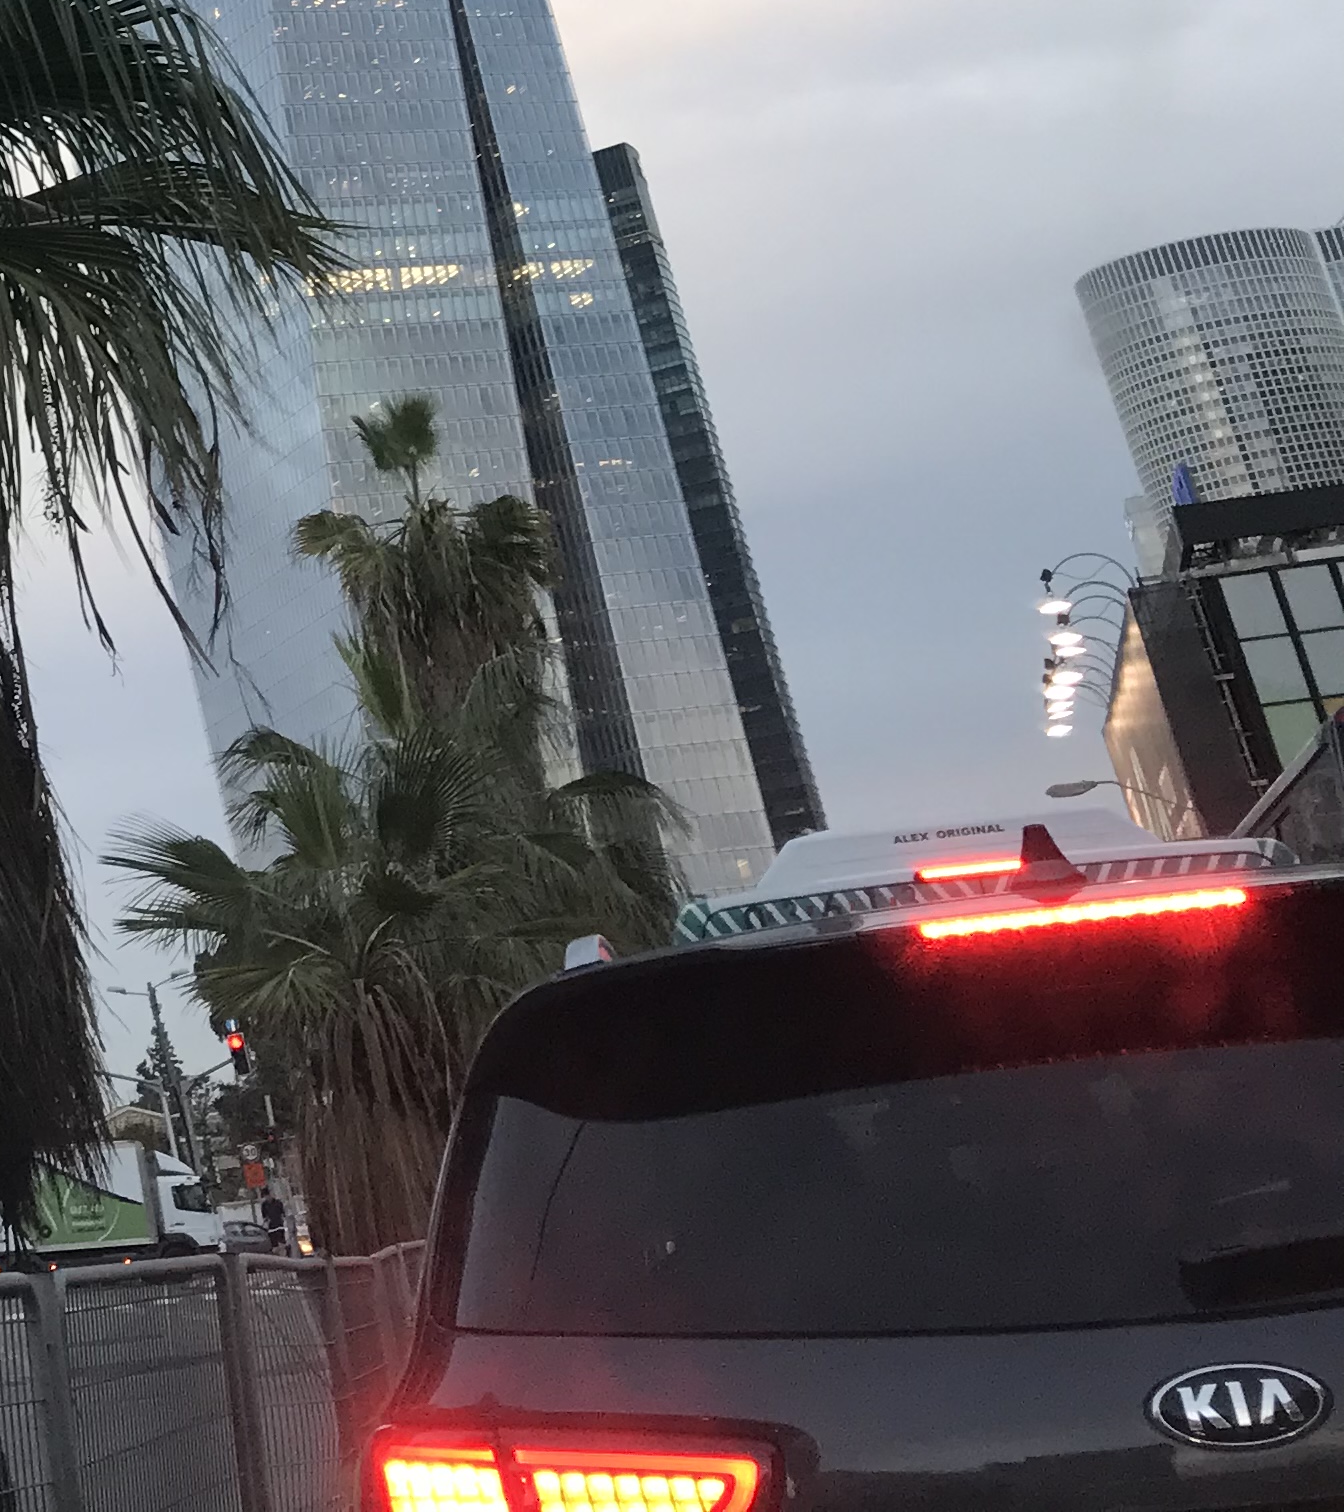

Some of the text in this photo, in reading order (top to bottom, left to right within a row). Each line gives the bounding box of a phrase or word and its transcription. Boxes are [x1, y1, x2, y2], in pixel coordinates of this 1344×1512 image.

[893, 824, 1005, 844] ALEX ORIGINAL
[1176, 1378, 1305, 1432] KIA
